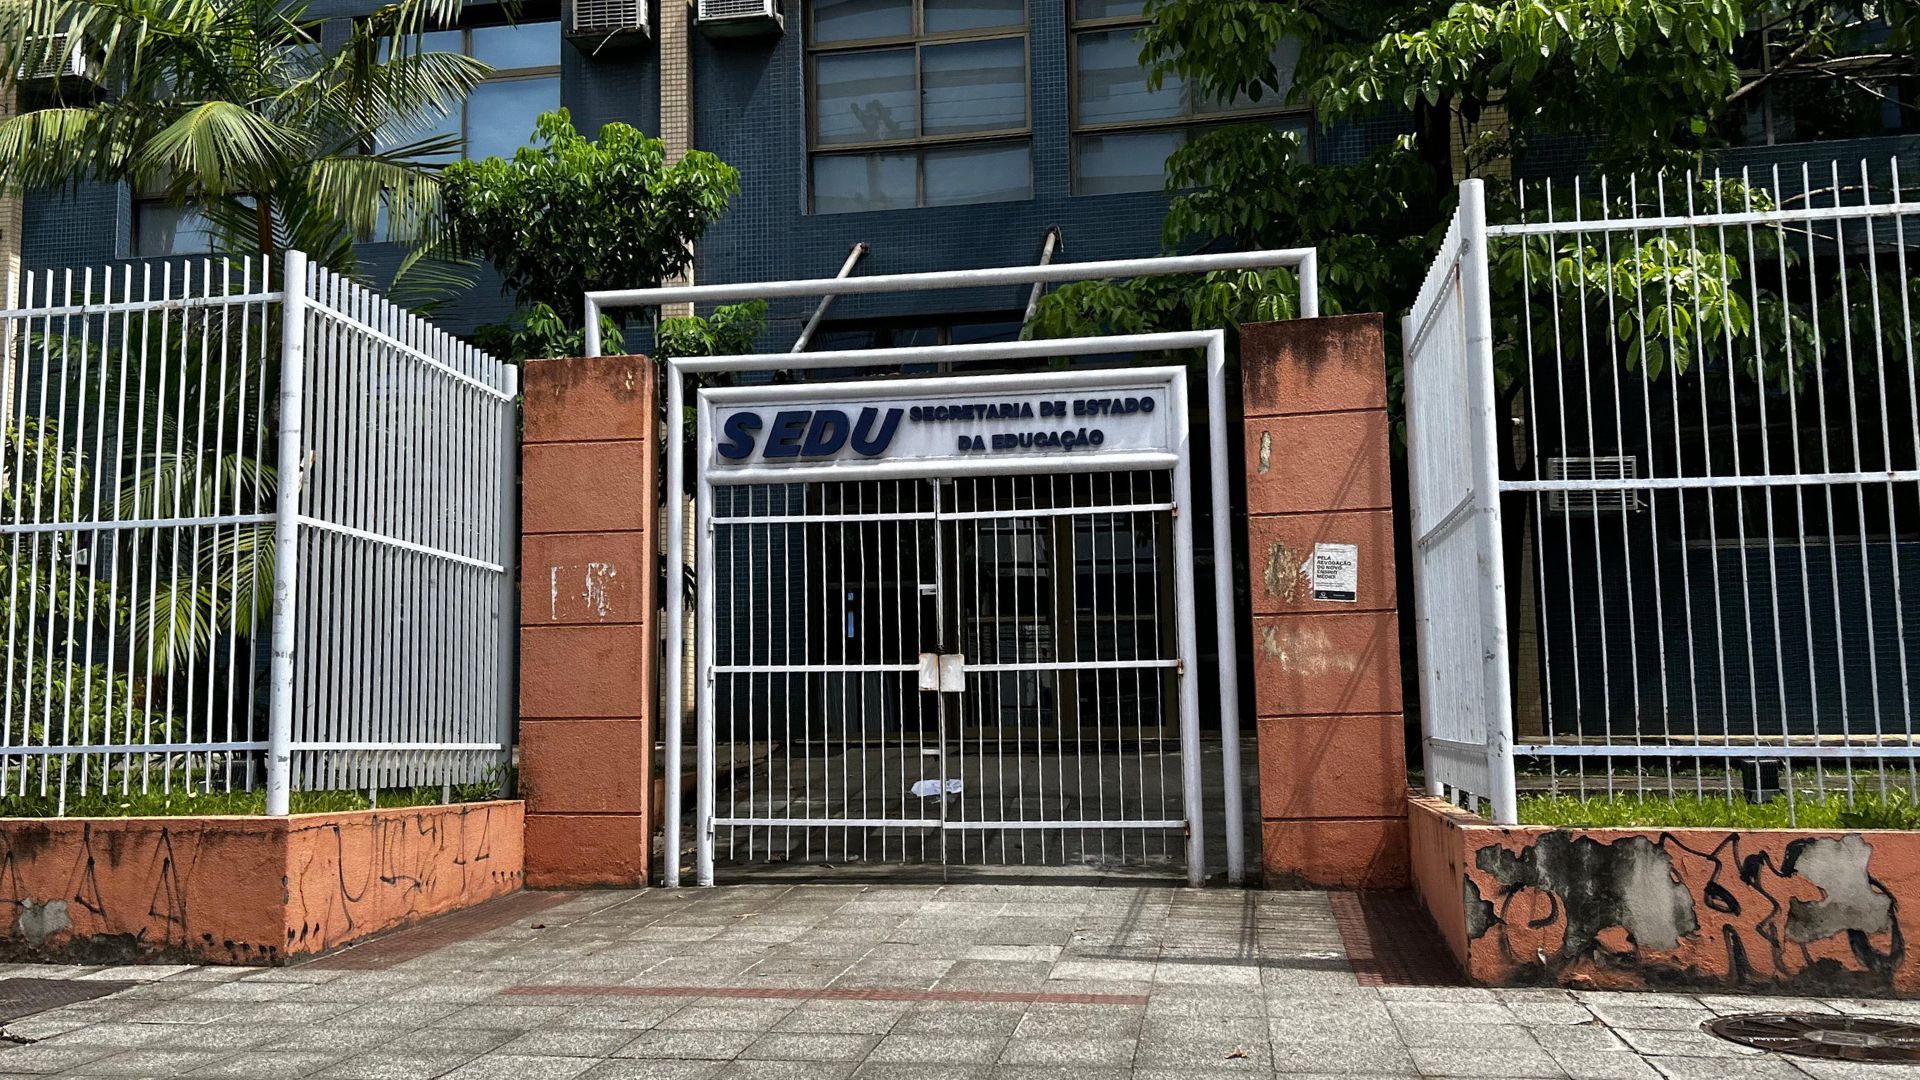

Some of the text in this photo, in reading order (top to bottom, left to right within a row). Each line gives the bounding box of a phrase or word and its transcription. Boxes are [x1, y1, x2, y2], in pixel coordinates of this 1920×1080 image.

[910, 397, 1155, 421] SECRETARIA DE ESTADO
[718, 407, 904, 459] SEDU
[958, 428, 1104, 451] DA EDUCAÇÃO
